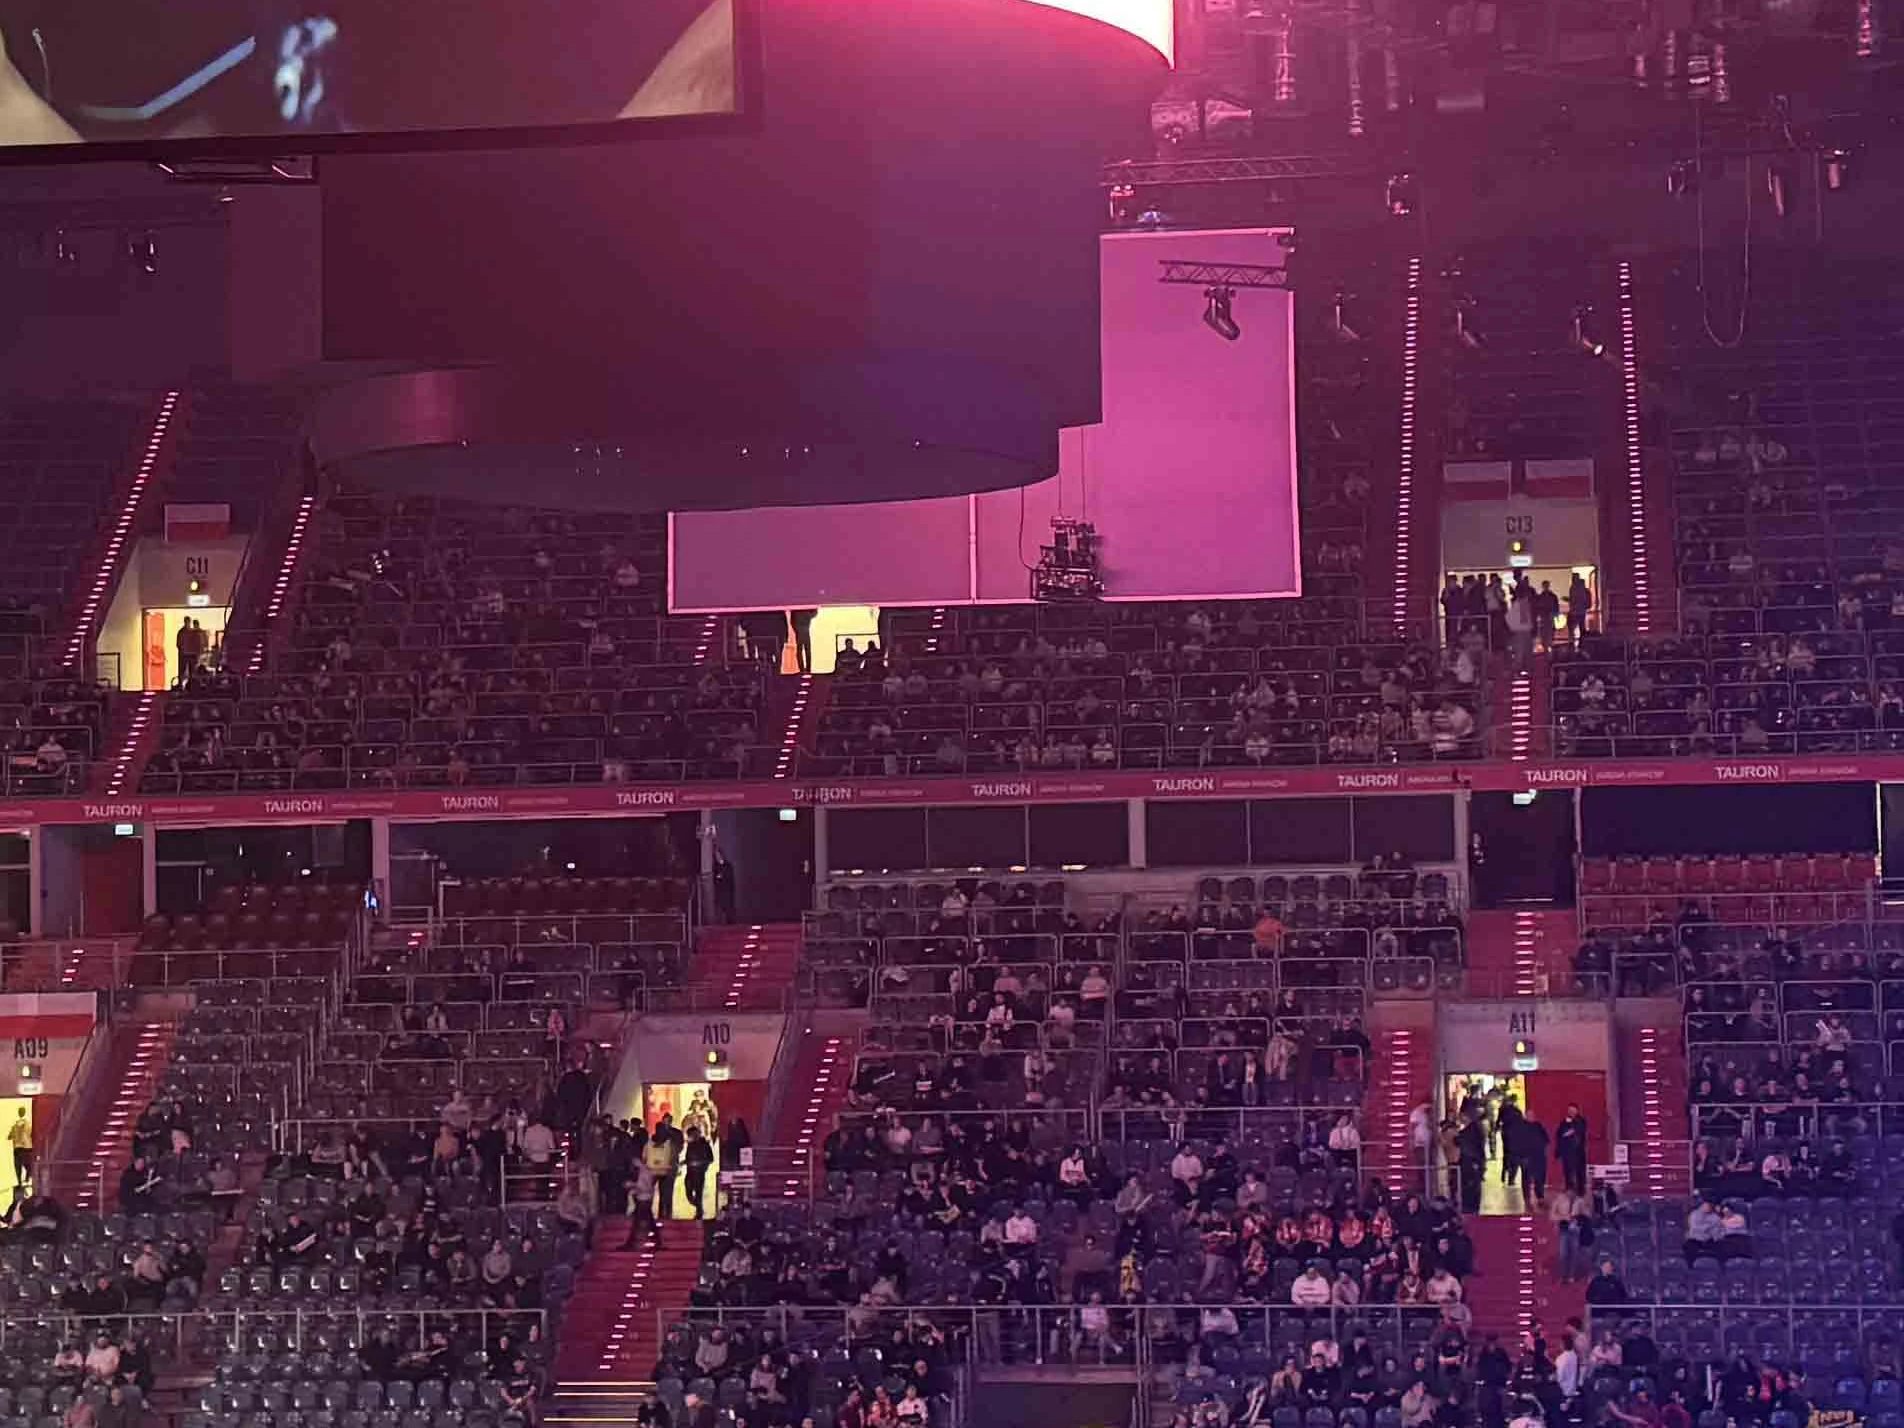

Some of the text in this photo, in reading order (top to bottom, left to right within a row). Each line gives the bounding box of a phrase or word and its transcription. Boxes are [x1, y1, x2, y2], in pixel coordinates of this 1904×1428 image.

[1505, 516, 1534, 533] C13
[1526, 770, 1587, 783] TAURON
[1714, 765, 1778, 780] TAURON
[1152, 778, 1213, 793] TAURON
[1337, 773, 1398, 788] TAURON
[971, 782, 1031, 796] TAURON
[264, 798, 323, 813] TAURON
[441, 796, 498, 810] TAURON
[615, 791, 674, 805] TAURON
[83, 805, 143, 818] TAURON
[1510, 1012, 1535, 1034] A11
[703, 1023, 731, 1044] A10
[15, 1037, 48, 1059] A09
